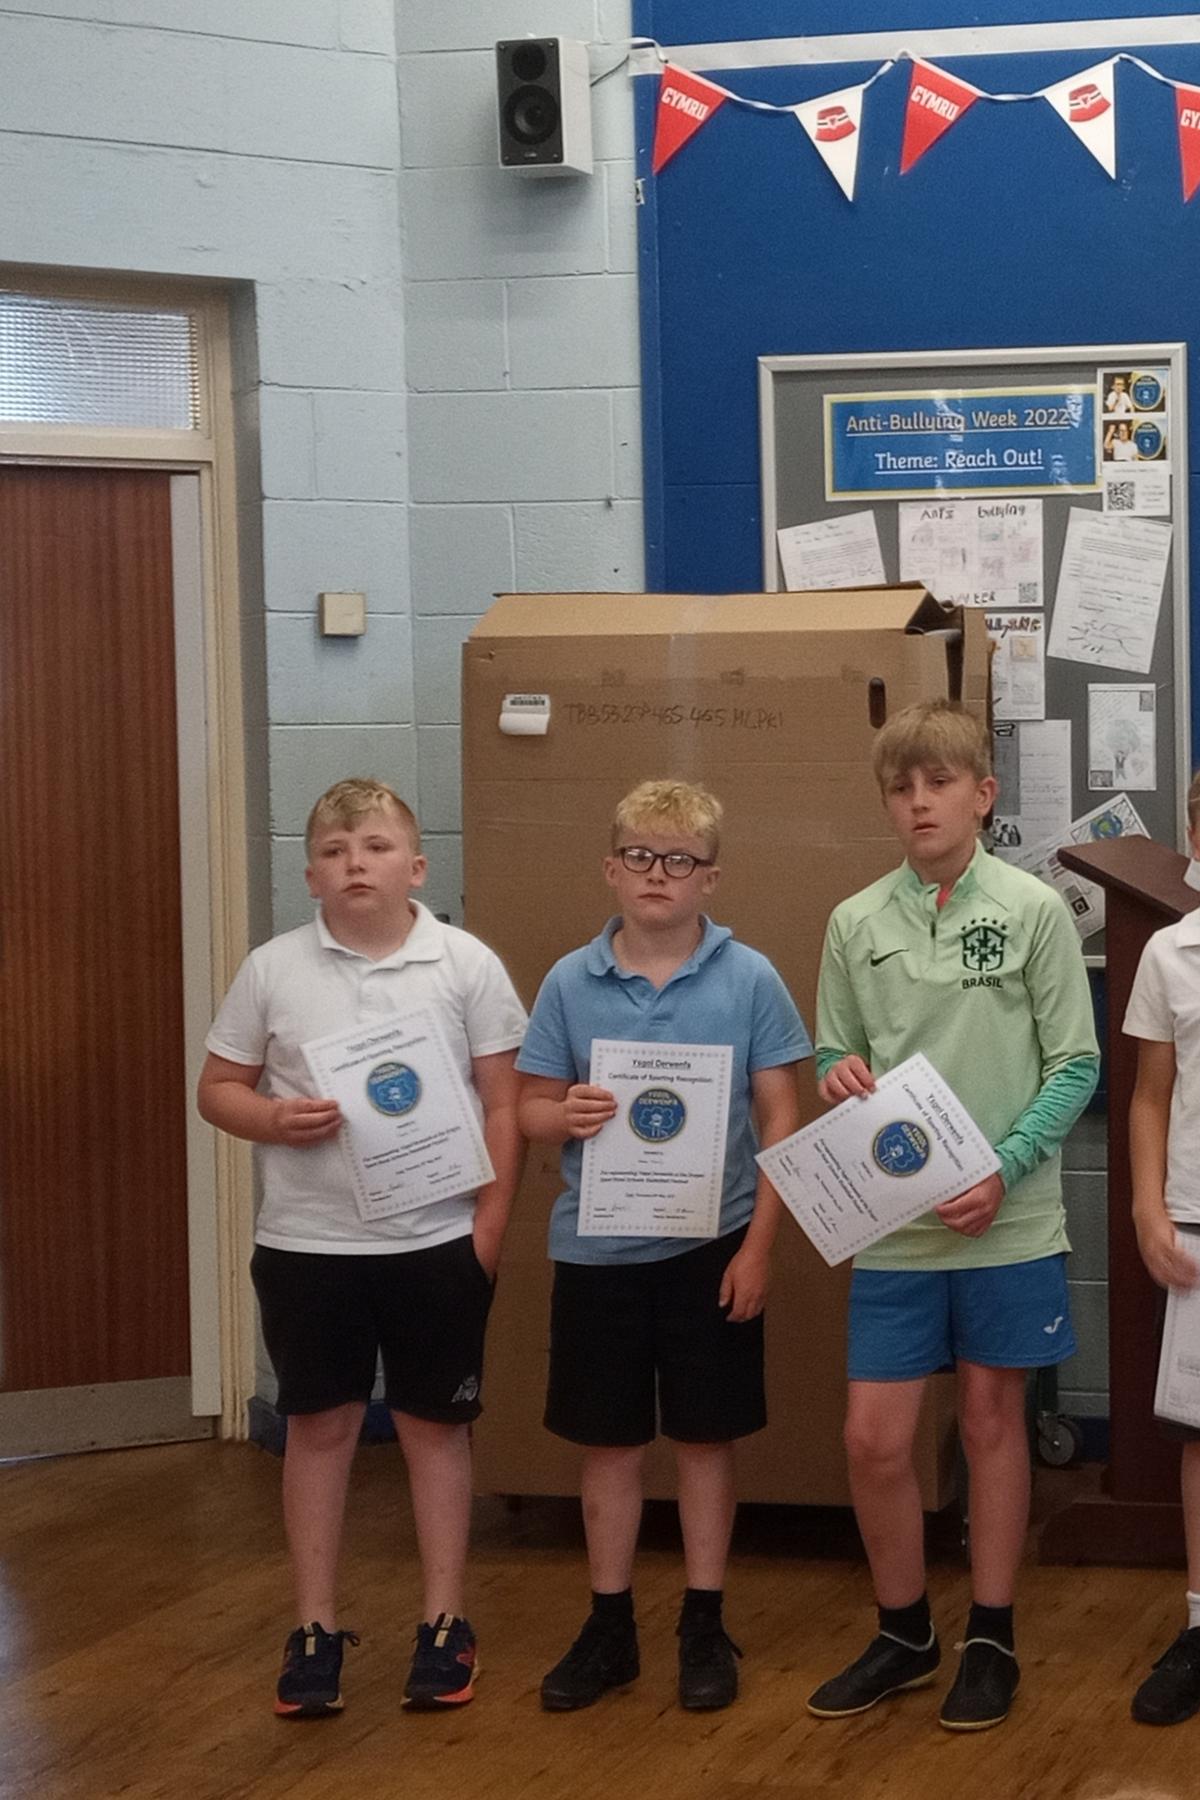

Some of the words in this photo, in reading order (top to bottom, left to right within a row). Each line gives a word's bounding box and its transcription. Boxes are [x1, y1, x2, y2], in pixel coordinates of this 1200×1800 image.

[660, 85, 708, 121] CYMRU
[910, 84, 959, 121] CYMRU
[846, 412, 965, 433] Anti-Bullying
[972, 409, 1018, 428] Week
[1024, 408, 1070, 427] 2022
[875, 453, 938, 470] Theme:
[945, 450, 997, 468] Reach
[1003, 448, 1043, 466] Out!
[962, 976, 1004, 990] BRASIL
